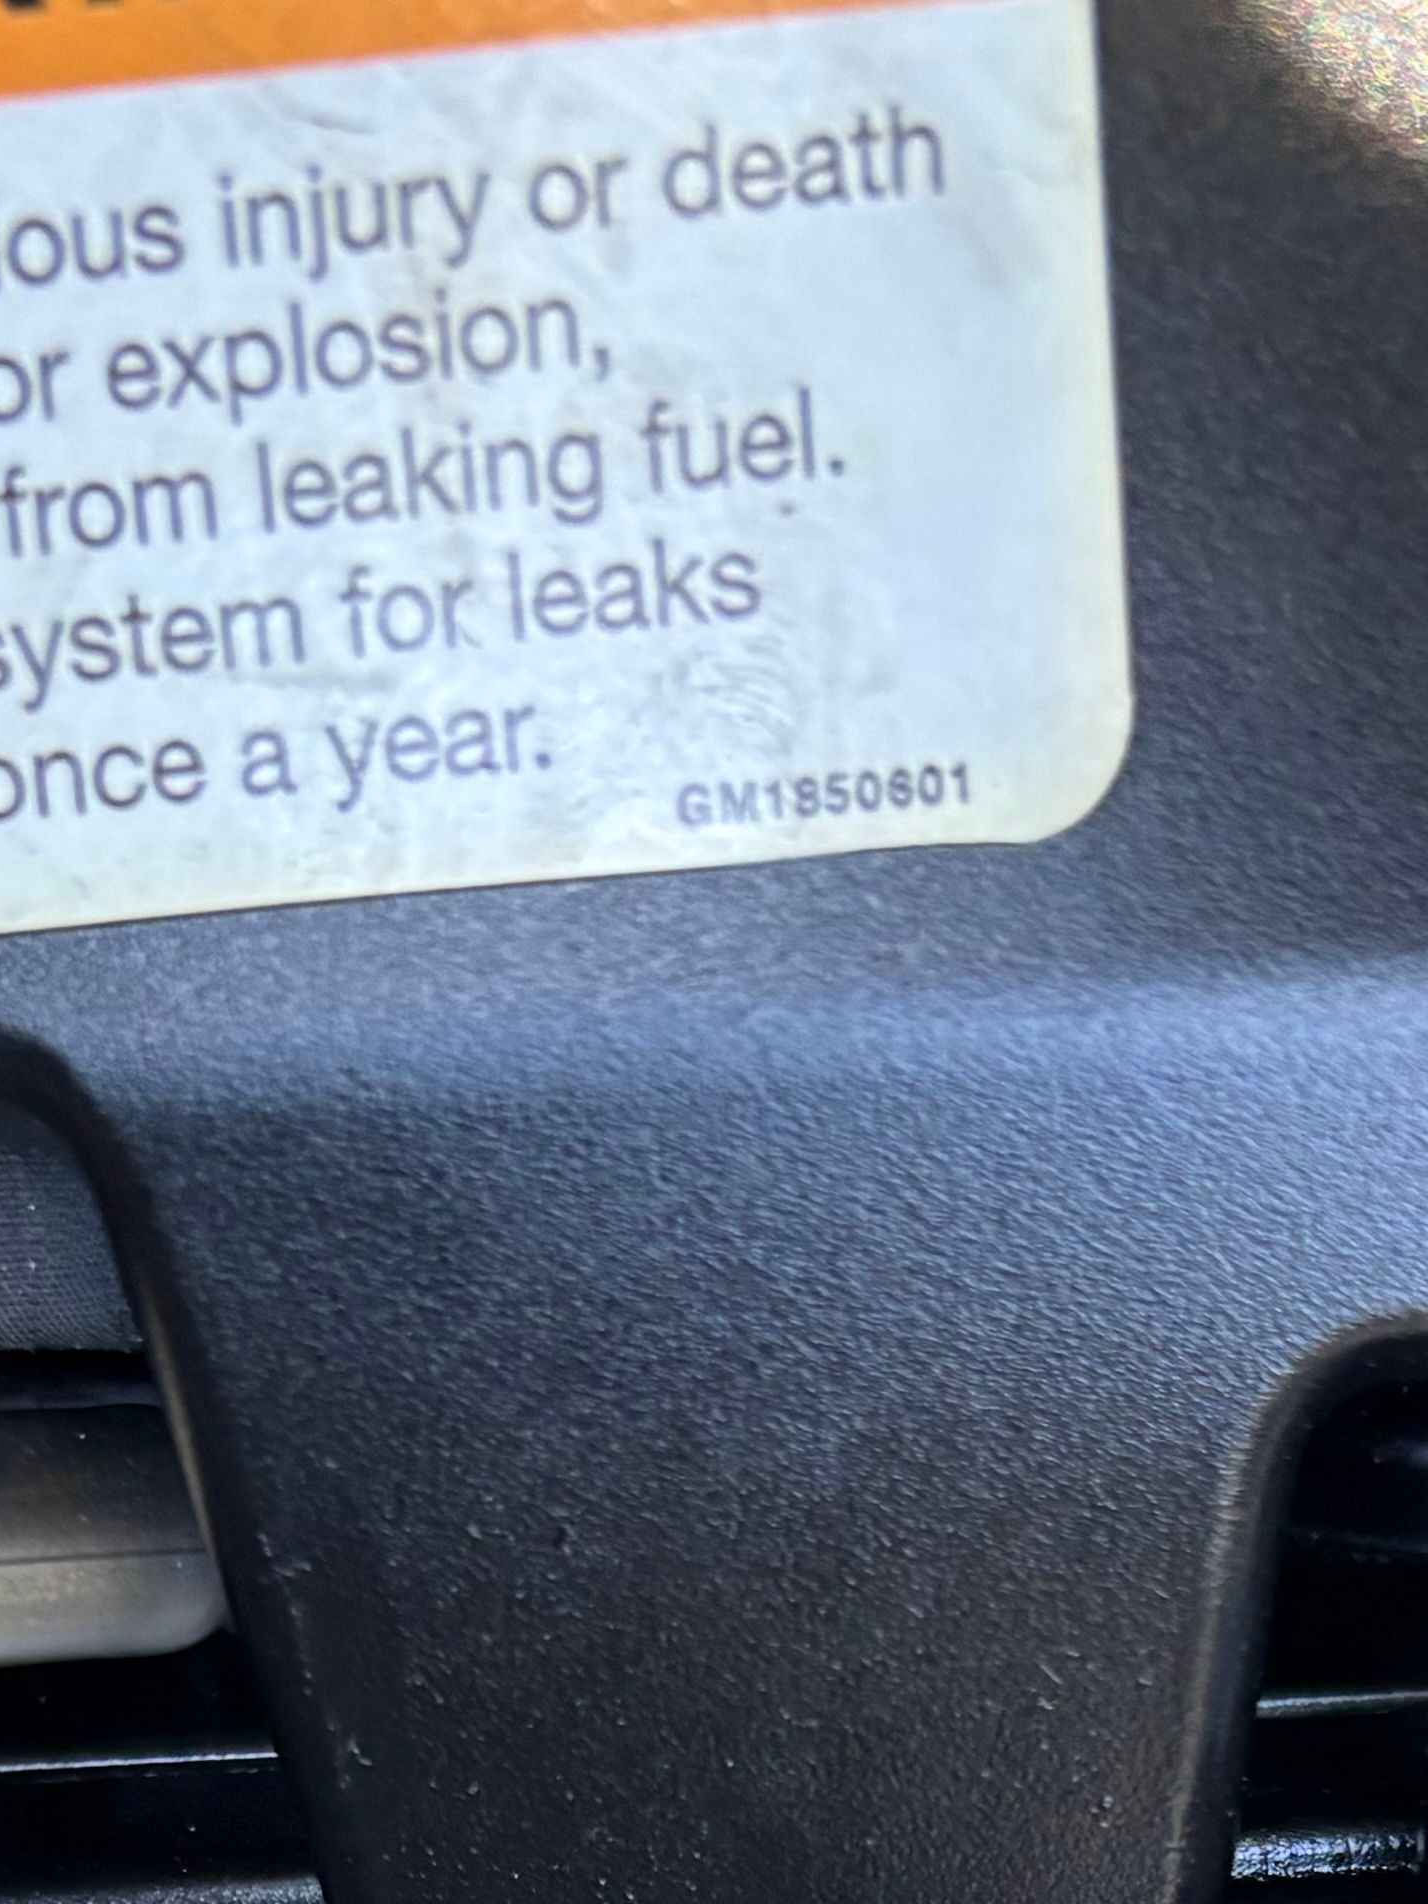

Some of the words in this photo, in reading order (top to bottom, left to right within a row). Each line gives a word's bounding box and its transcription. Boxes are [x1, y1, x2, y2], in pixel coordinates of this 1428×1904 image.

[218, 163, 490, 283] injury
[528, 155, 627, 232] or
[663, 104, 945, 219] death
[107, 289, 610, 427] explosion,
[0, 466, 218, 558] from
[257, 421, 603, 533] leaking
[641, 387, 845, 494] fuel.
[338, 565, 475, 657] for
[507, 537, 761, 641] leaks
[241, 731, 297, 796] a
[326, 706, 552, 811] year.
